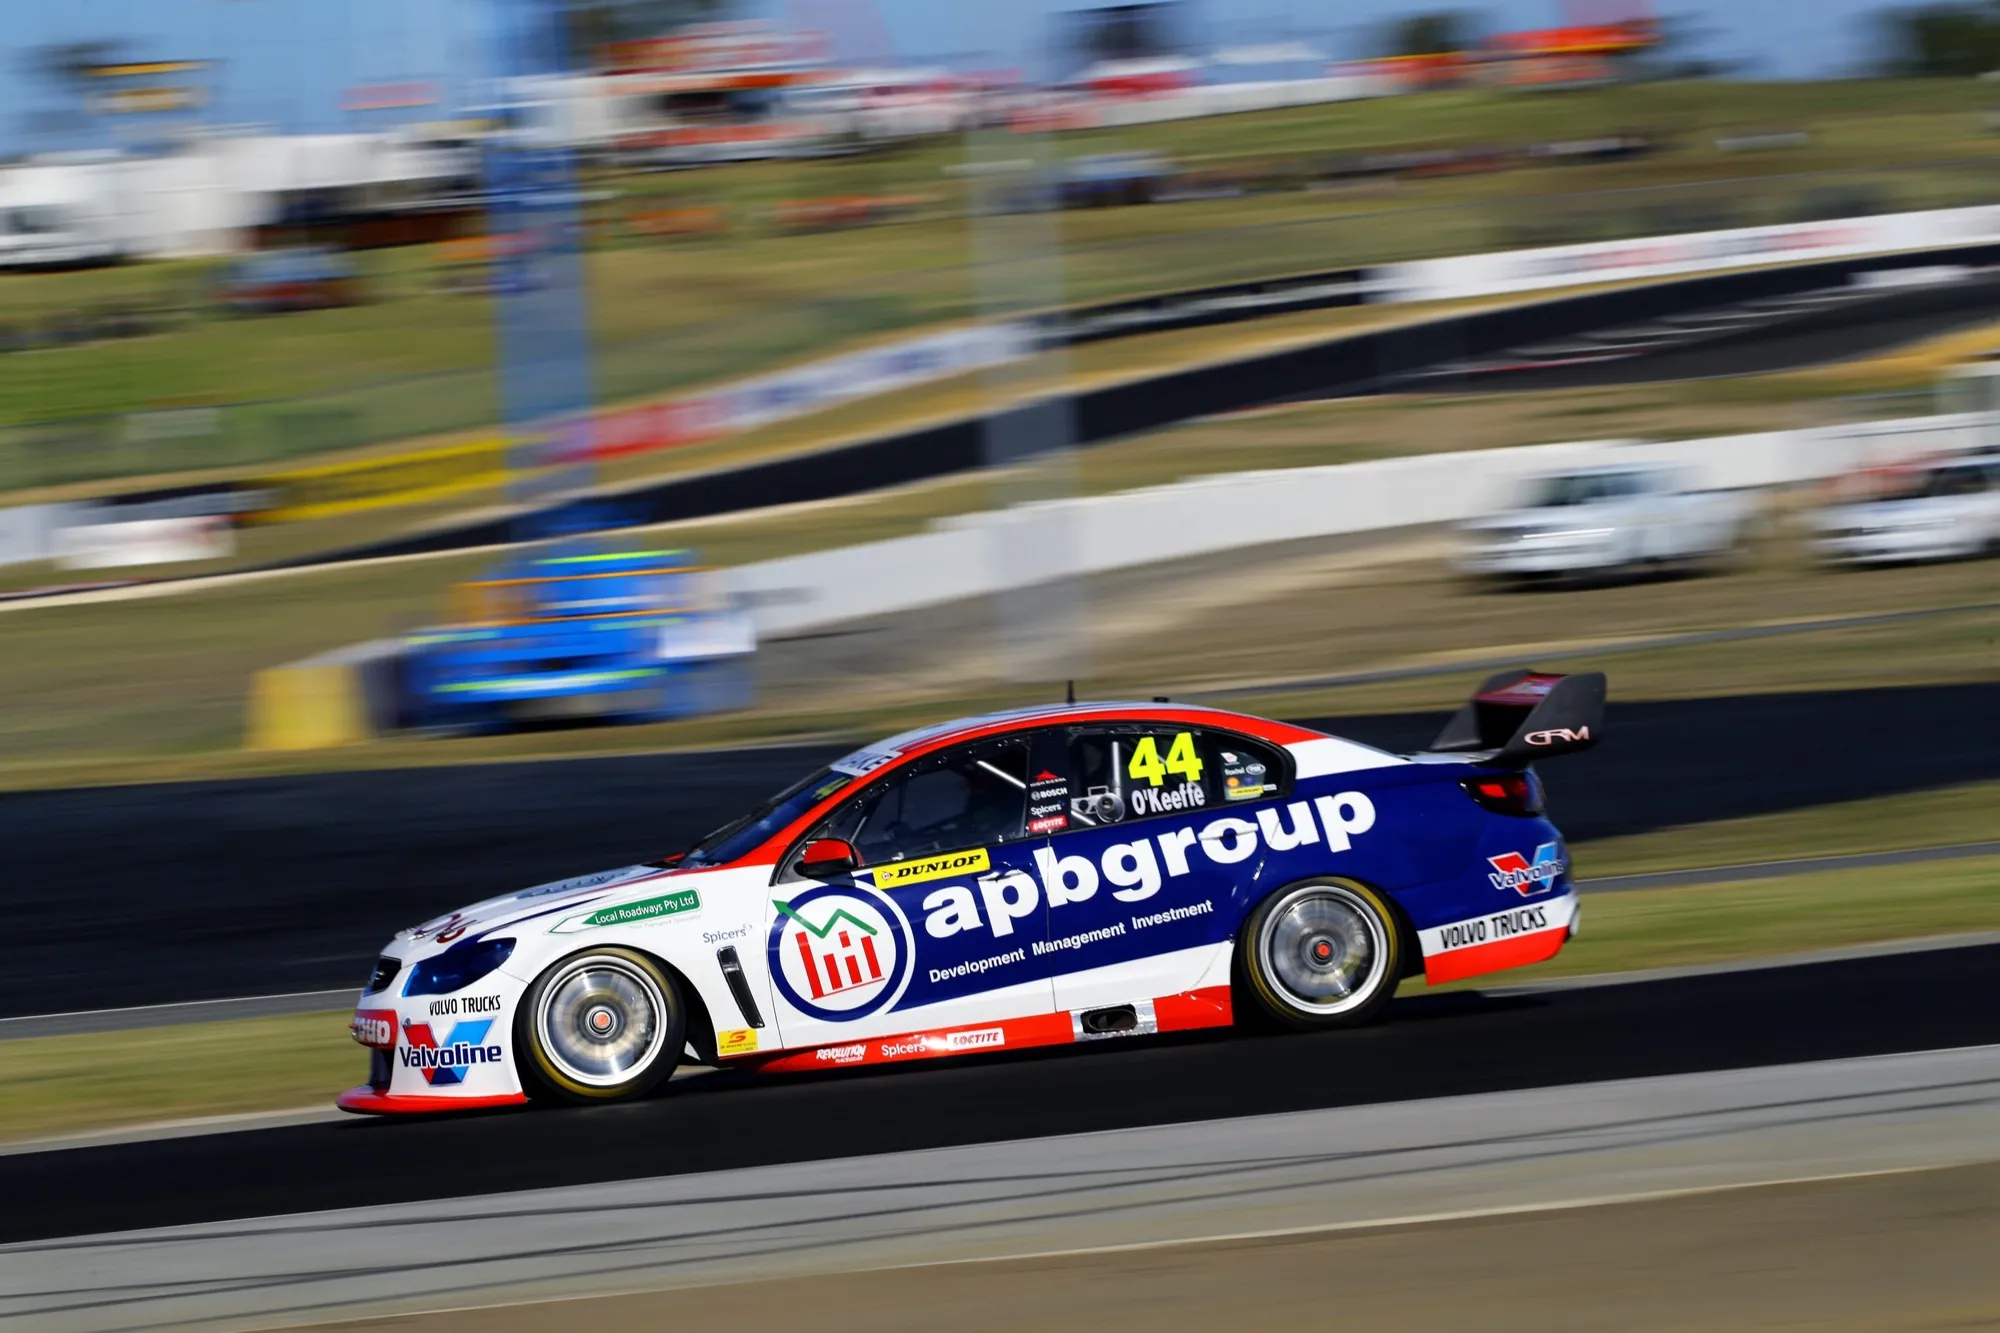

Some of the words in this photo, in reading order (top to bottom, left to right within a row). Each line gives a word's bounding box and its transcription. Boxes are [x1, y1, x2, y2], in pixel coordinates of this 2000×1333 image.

[1128, 732, 1203, 786] 44
[1040, 787, 1067, 798] BOSCH
[1131, 781, 1206, 815] O'Keeffe
[1030, 804, 1062, 818] Spicers
[896, 854, 982, 878] DUNLOP
[922, 790, 1376, 938] apbgroup
[595, 911, 618, 924] Local
[619, 902, 663, 919] Roadways
[664, 900, 678, 912] Pty
[680, 895, 694, 907] Ltd
[703, 928, 747, 944] Spicers
[1441, 920, 1486, 949] VOLVO
[1491, 906, 1547, 938] TRUCKS
[929, 948, 1026, 983] Development
[1032, 922, 1126, 956] Management
[1131, 900, 1213, 930] Investment
[430, 998, 458, 1016] VOLVO
[462, 995, 501, 1013] TRUCKS
[881, 1043, 926, 1057] Spicers
[953, 1031, 1000, 1045] LOCTITE
[399, 1042, 502, 1068] Valvoline
[816, 1045, 866, 1061] REVOLUTION
